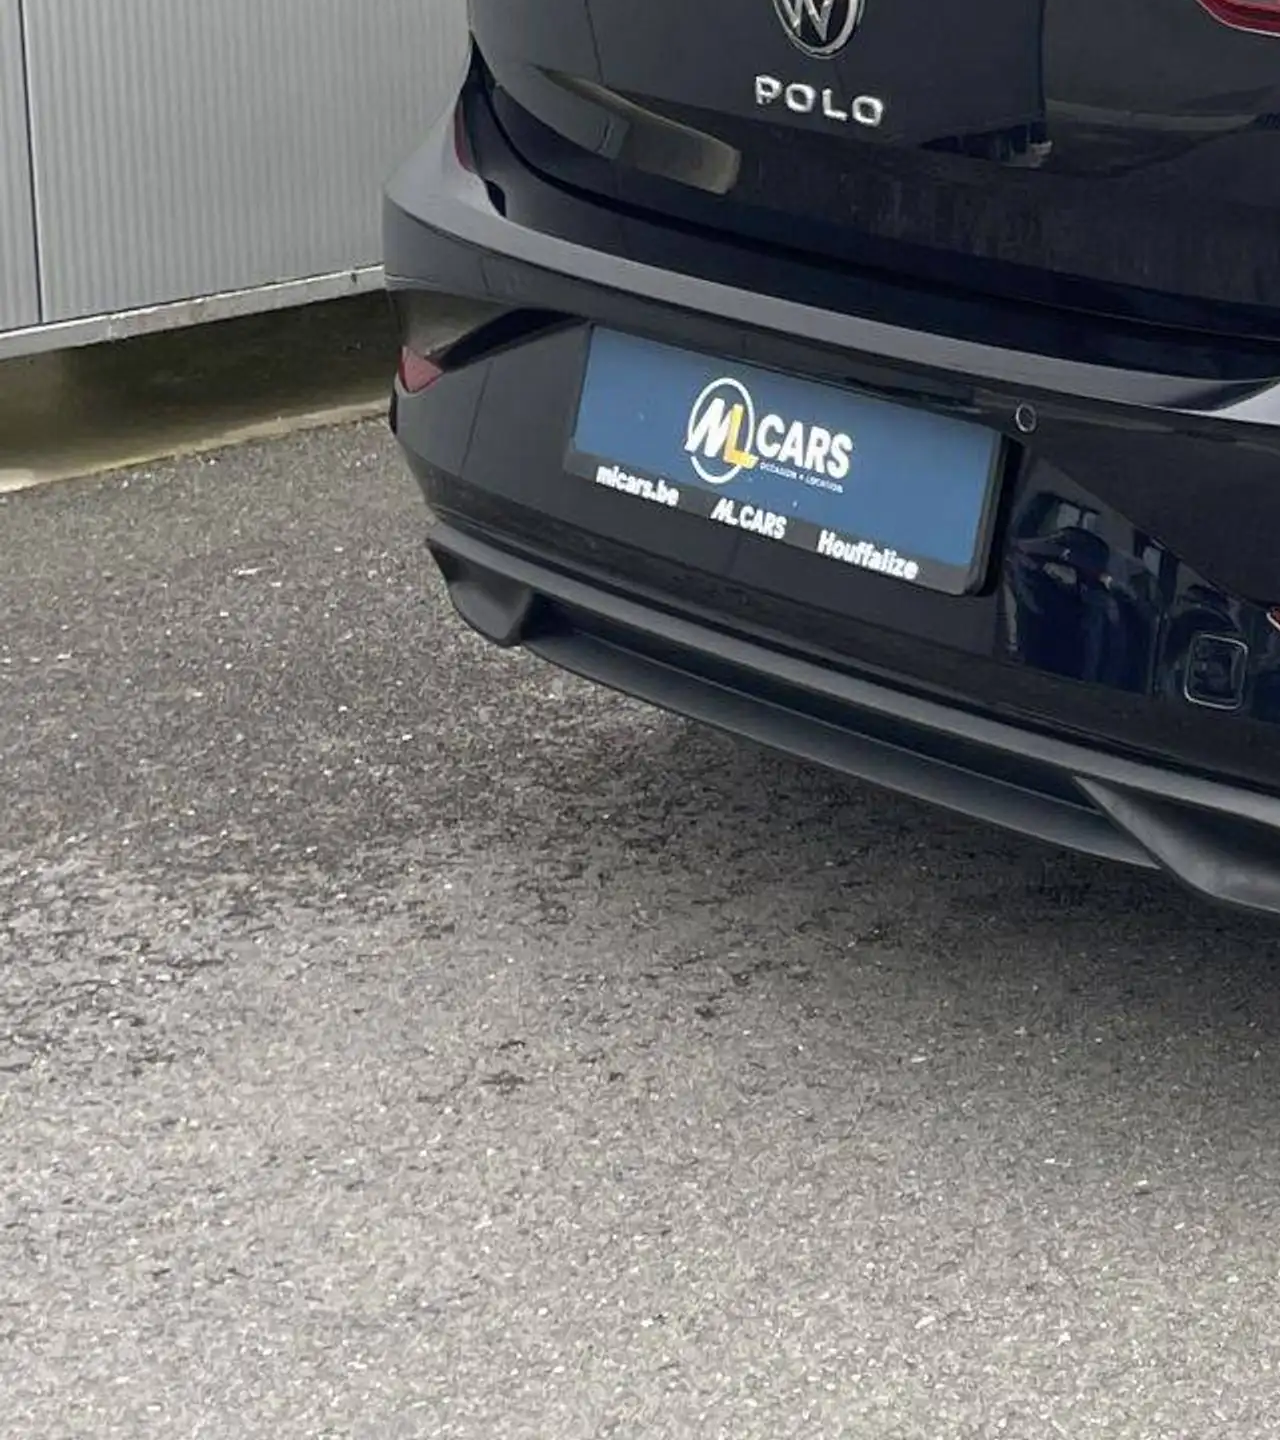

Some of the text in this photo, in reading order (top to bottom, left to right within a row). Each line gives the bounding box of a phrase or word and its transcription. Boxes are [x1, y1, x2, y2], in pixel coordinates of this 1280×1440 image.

[755, 74, 884, 127] POLO
[684, 397, 853, 479] ML CARS
[816, 528, 919, 580] Houffalize
